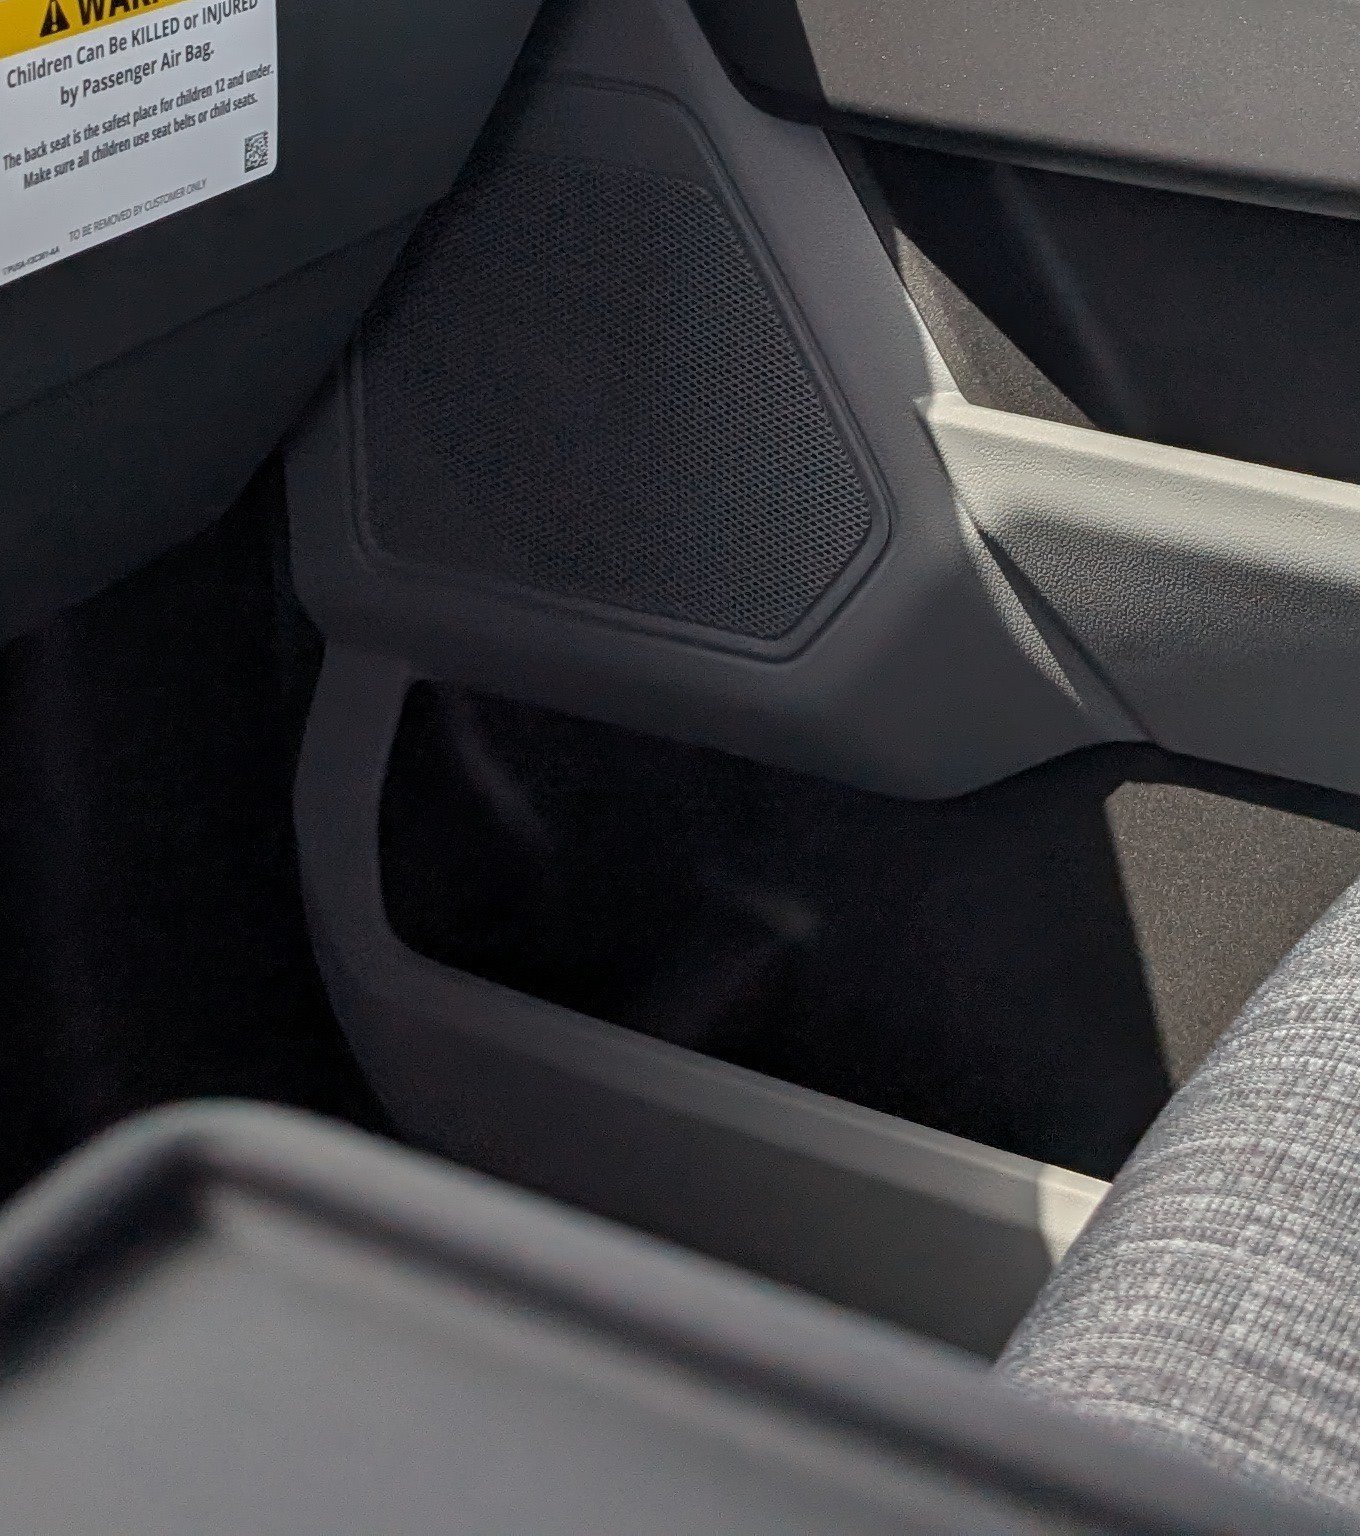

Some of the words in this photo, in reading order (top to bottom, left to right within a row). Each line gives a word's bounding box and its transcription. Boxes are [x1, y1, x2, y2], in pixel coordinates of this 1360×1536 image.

[7, 50, 73, 89] Children
[77, 43, 104, 66] Can
[109, 35, 127, 55] Be
[131, 17, 180, 49] KILLED
[184, 13, 197, 30] or
[60, 84, 78, 106] by
[83, 60, 157, 97] Passenger
[161, 48, 181, 73] Air
[185, 41, 215, 63] Bag.
[3, 154, 21, 170] The
[25, 141, 47, 163] back
[50, 134, 70, 152] seat
[73, 129, 81, 145] is
[84, 124, 100, 141] the
[102, 113, 130, 135] safest
[134, 103, 157, 127] place
[160, 97, 175, 114] for
[176, 86, 212, 108] children
[215, 78, 225, 93] 12
[228, 71, 244, 89] and
[246, 63, 274, 84] under.
[24, 167, 51, 189] Make
[54, 161, 75, 178] sure
[78, 151, 89, 167] all
[92, 137, 130, 162] children
[133, 131, 149, 147] use
[152, 124, 171, 141] seat
[174, 114, 196, 133] belts
[198, 111, 208, 123] or
[210, 99, 231, 119] child
[233, 91, 258, 111] seats.
[69, 230, 81, 242] TO
[82, 226, 91, 237] BE
[94, 208, 132, 234] REMOVED
[134, 204, 143, 217] BY
[145, 187, 185, 212] CUSTOMER
[187, 178, 207, 195] ONLY
